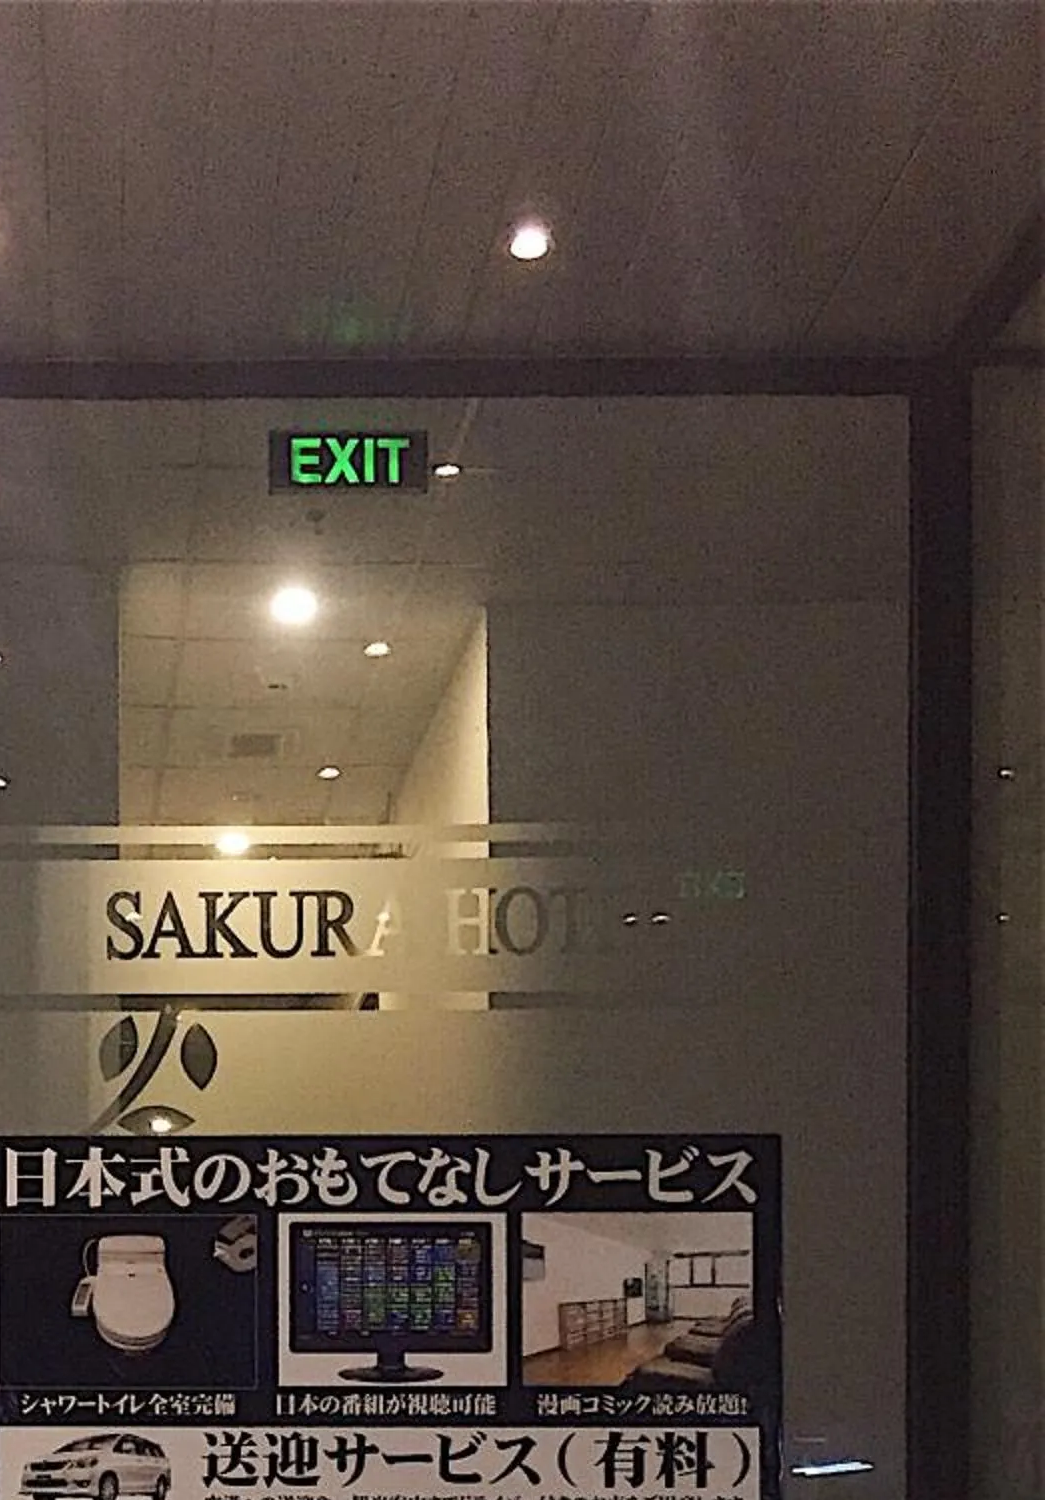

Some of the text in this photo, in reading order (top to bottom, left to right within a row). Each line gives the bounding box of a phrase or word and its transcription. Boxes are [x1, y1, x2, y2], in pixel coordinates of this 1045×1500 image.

[290, 437, 410, 484] EXIT
[5, 1146, 758, 1208] 日本式のおもてなしサービス
[21, 1393, 236, 1416] シャワートイレ全室完備
[275, 1393, 497, 1416] 日本の番組が視聴可能
